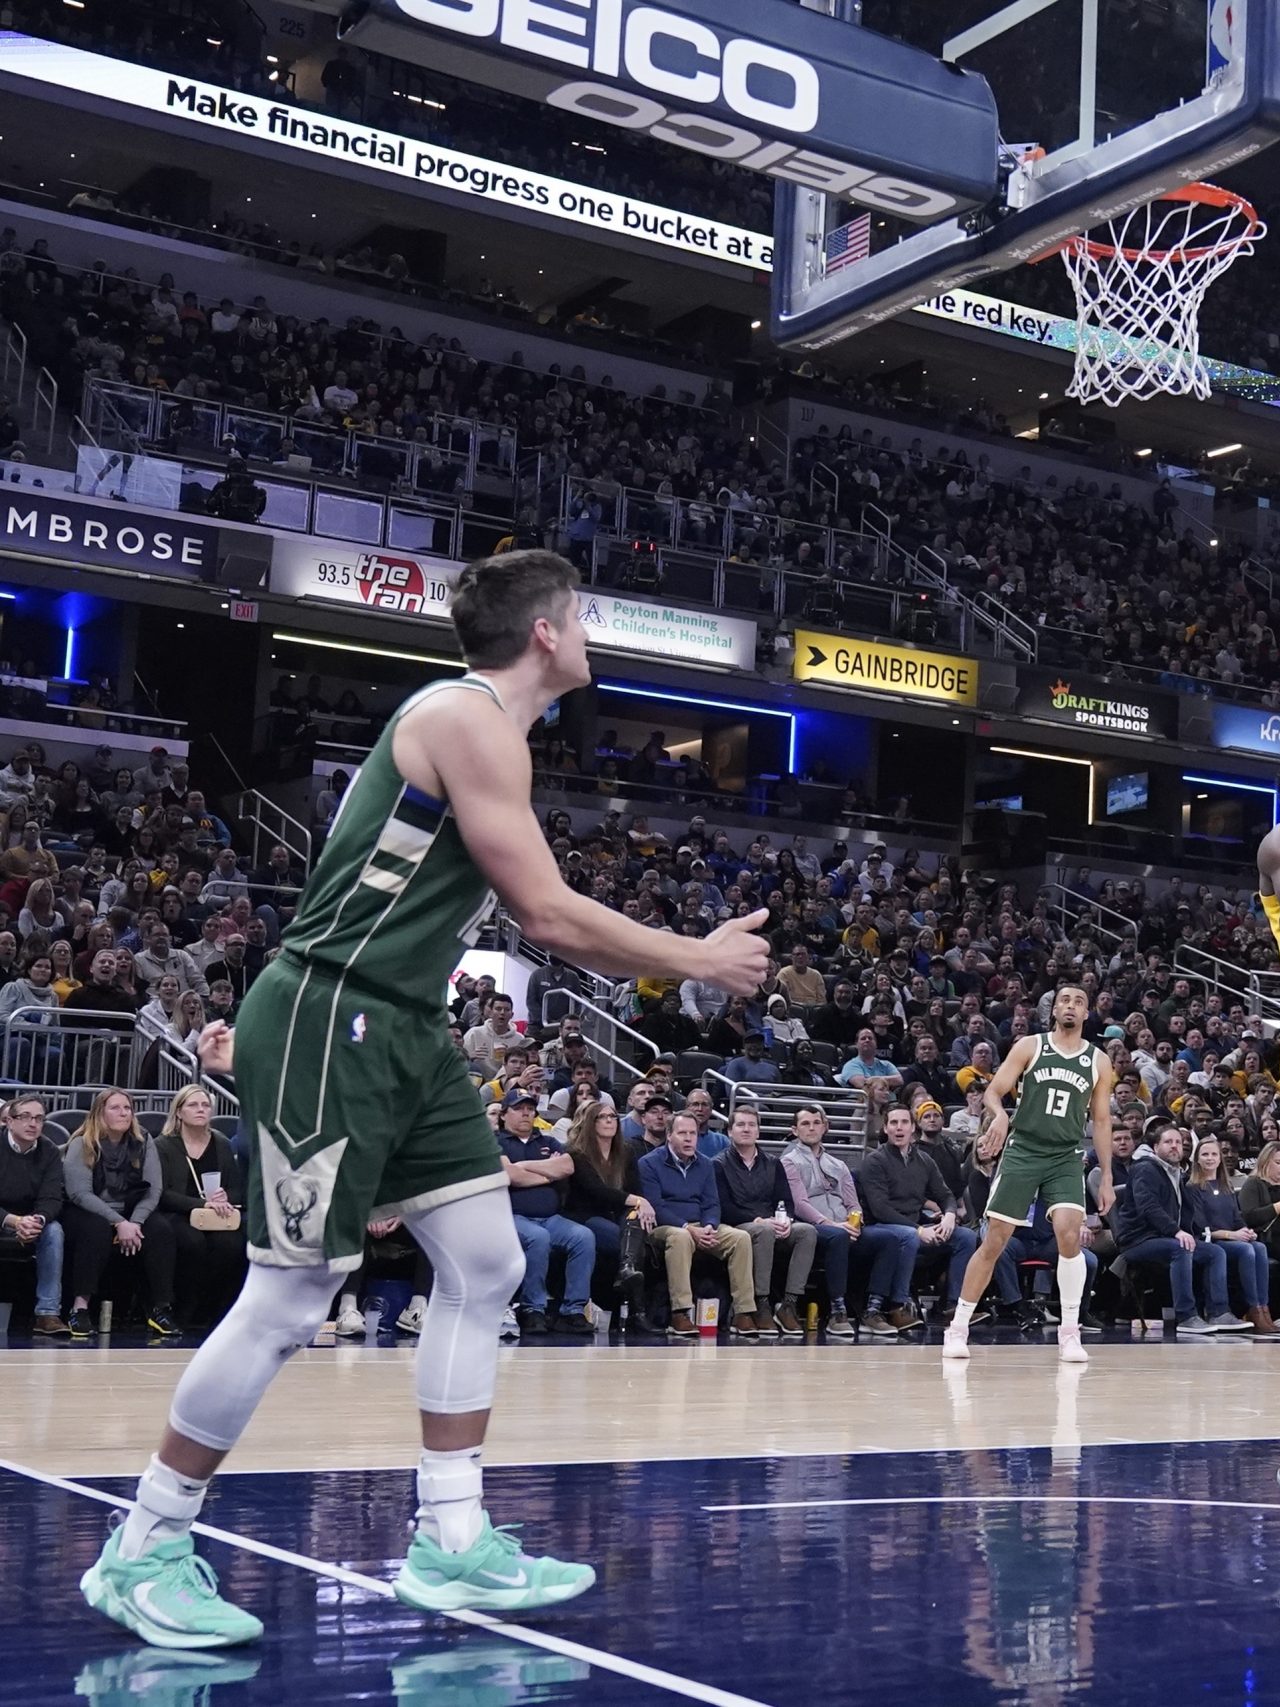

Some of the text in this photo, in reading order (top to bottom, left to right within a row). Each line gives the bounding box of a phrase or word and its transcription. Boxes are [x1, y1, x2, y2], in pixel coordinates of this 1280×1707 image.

[166, 79, 258, 127] Make
[268, 106, 405, 167] financial
[415, 150, 549, 205] progress
[558, 191, 614, 222] one
[623, 202, 719, 250] bucket
[726, 235, 752, 260] at
[963, 304, 1003, 326] red
[1010, 307, 1053, 341] key.
[6, 506, 204, 566] MBROSE
[318, 562, 350, 586] 93.5
[354, 553, 410, 587] the
[366, 581, 425, 614] fan
[429, 581, 450, 602] 10
[235, 603, 255, 619] EXIT
[613, 601, 718, 632] Peyton Manning
[613, 618, 732, 648] Children's Hospital
[835, 648, 969, 695] GAINBRIDGE
[1052, 692, 1149, 720] DRAFTKINGS
[1075, 710, 1149, 733] SPORTSBOOK
[1033, 1067, 1091, 1094] MILWAUKEE
[1045, 1087, 1071, 1118] 13
